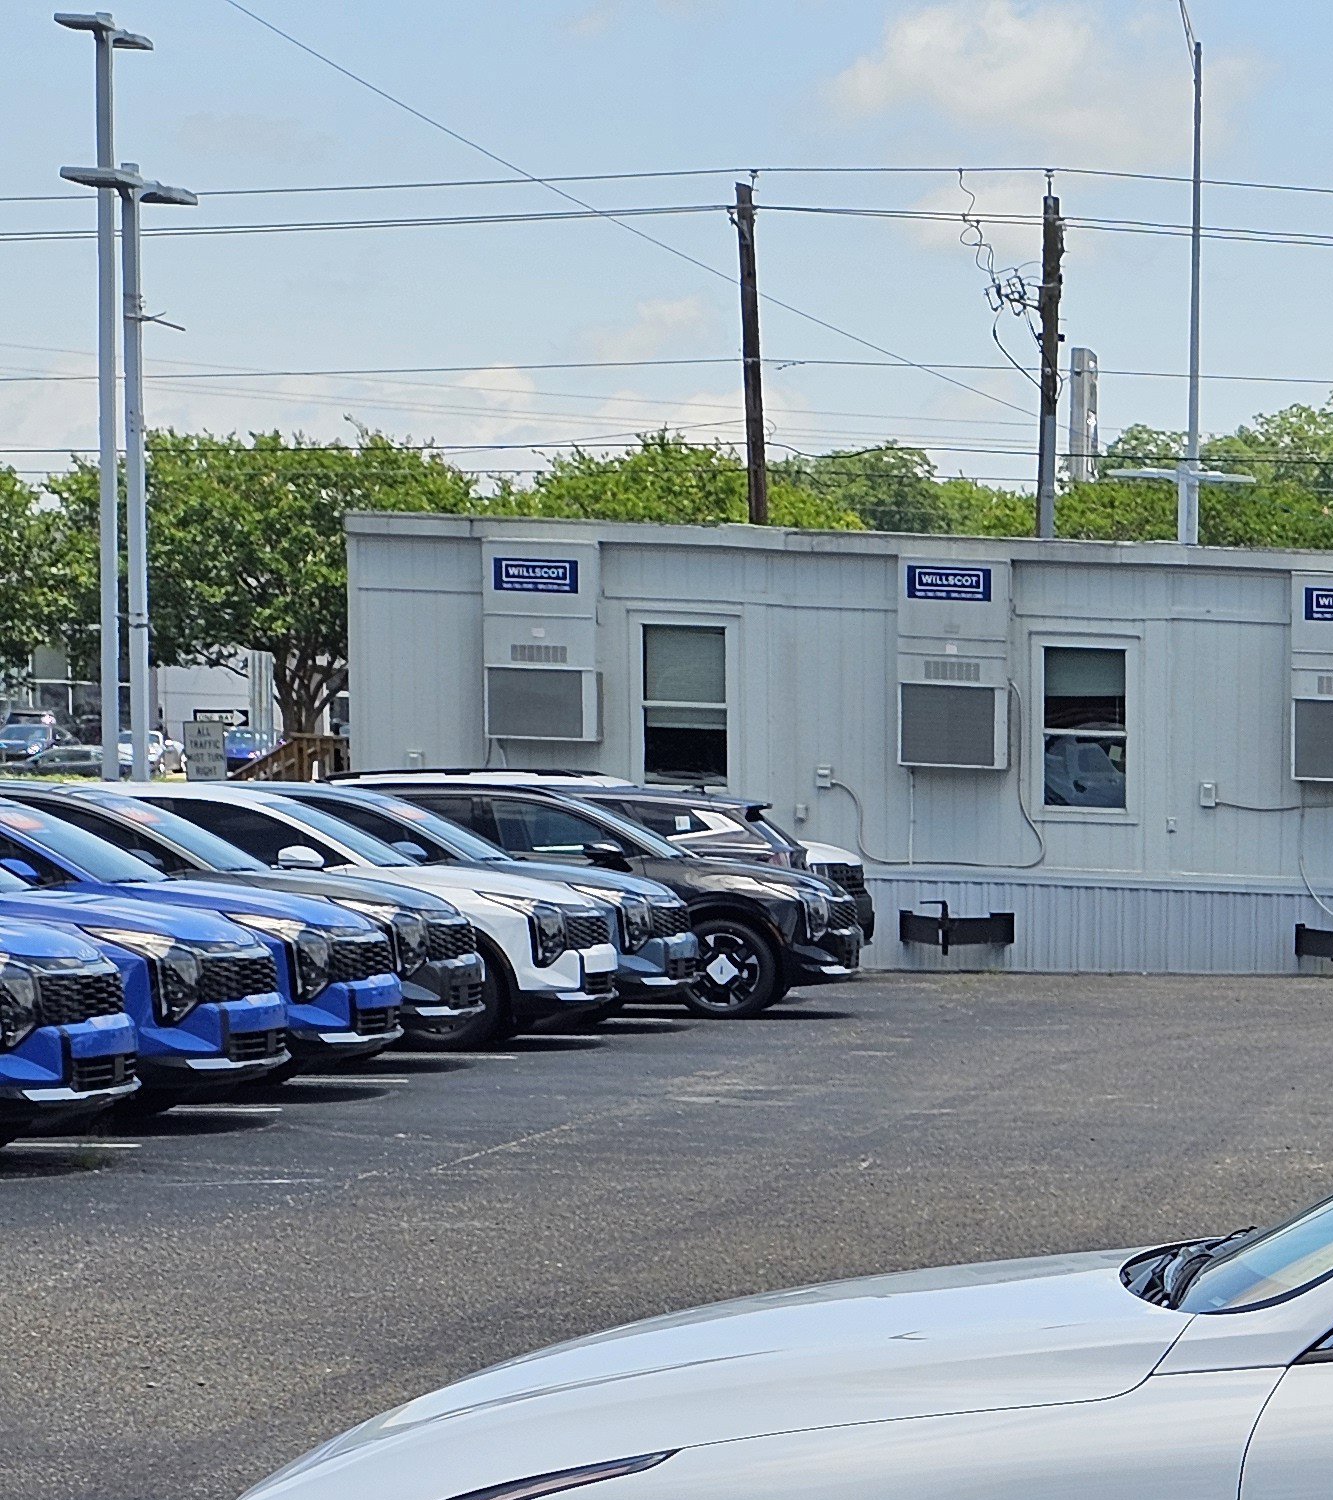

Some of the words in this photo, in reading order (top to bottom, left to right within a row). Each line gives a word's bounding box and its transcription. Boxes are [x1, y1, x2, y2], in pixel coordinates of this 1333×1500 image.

[508, 566, 564, 578] WILLSCOT
[921, 574, 979, 587] WILLSCOT
[197, 726, 211, 736] ALL
[190, 740, 220, 749] TRAFFIC
[208, 753, 224, 761] TURN
[195, 766, 217, 776] RIGHT
